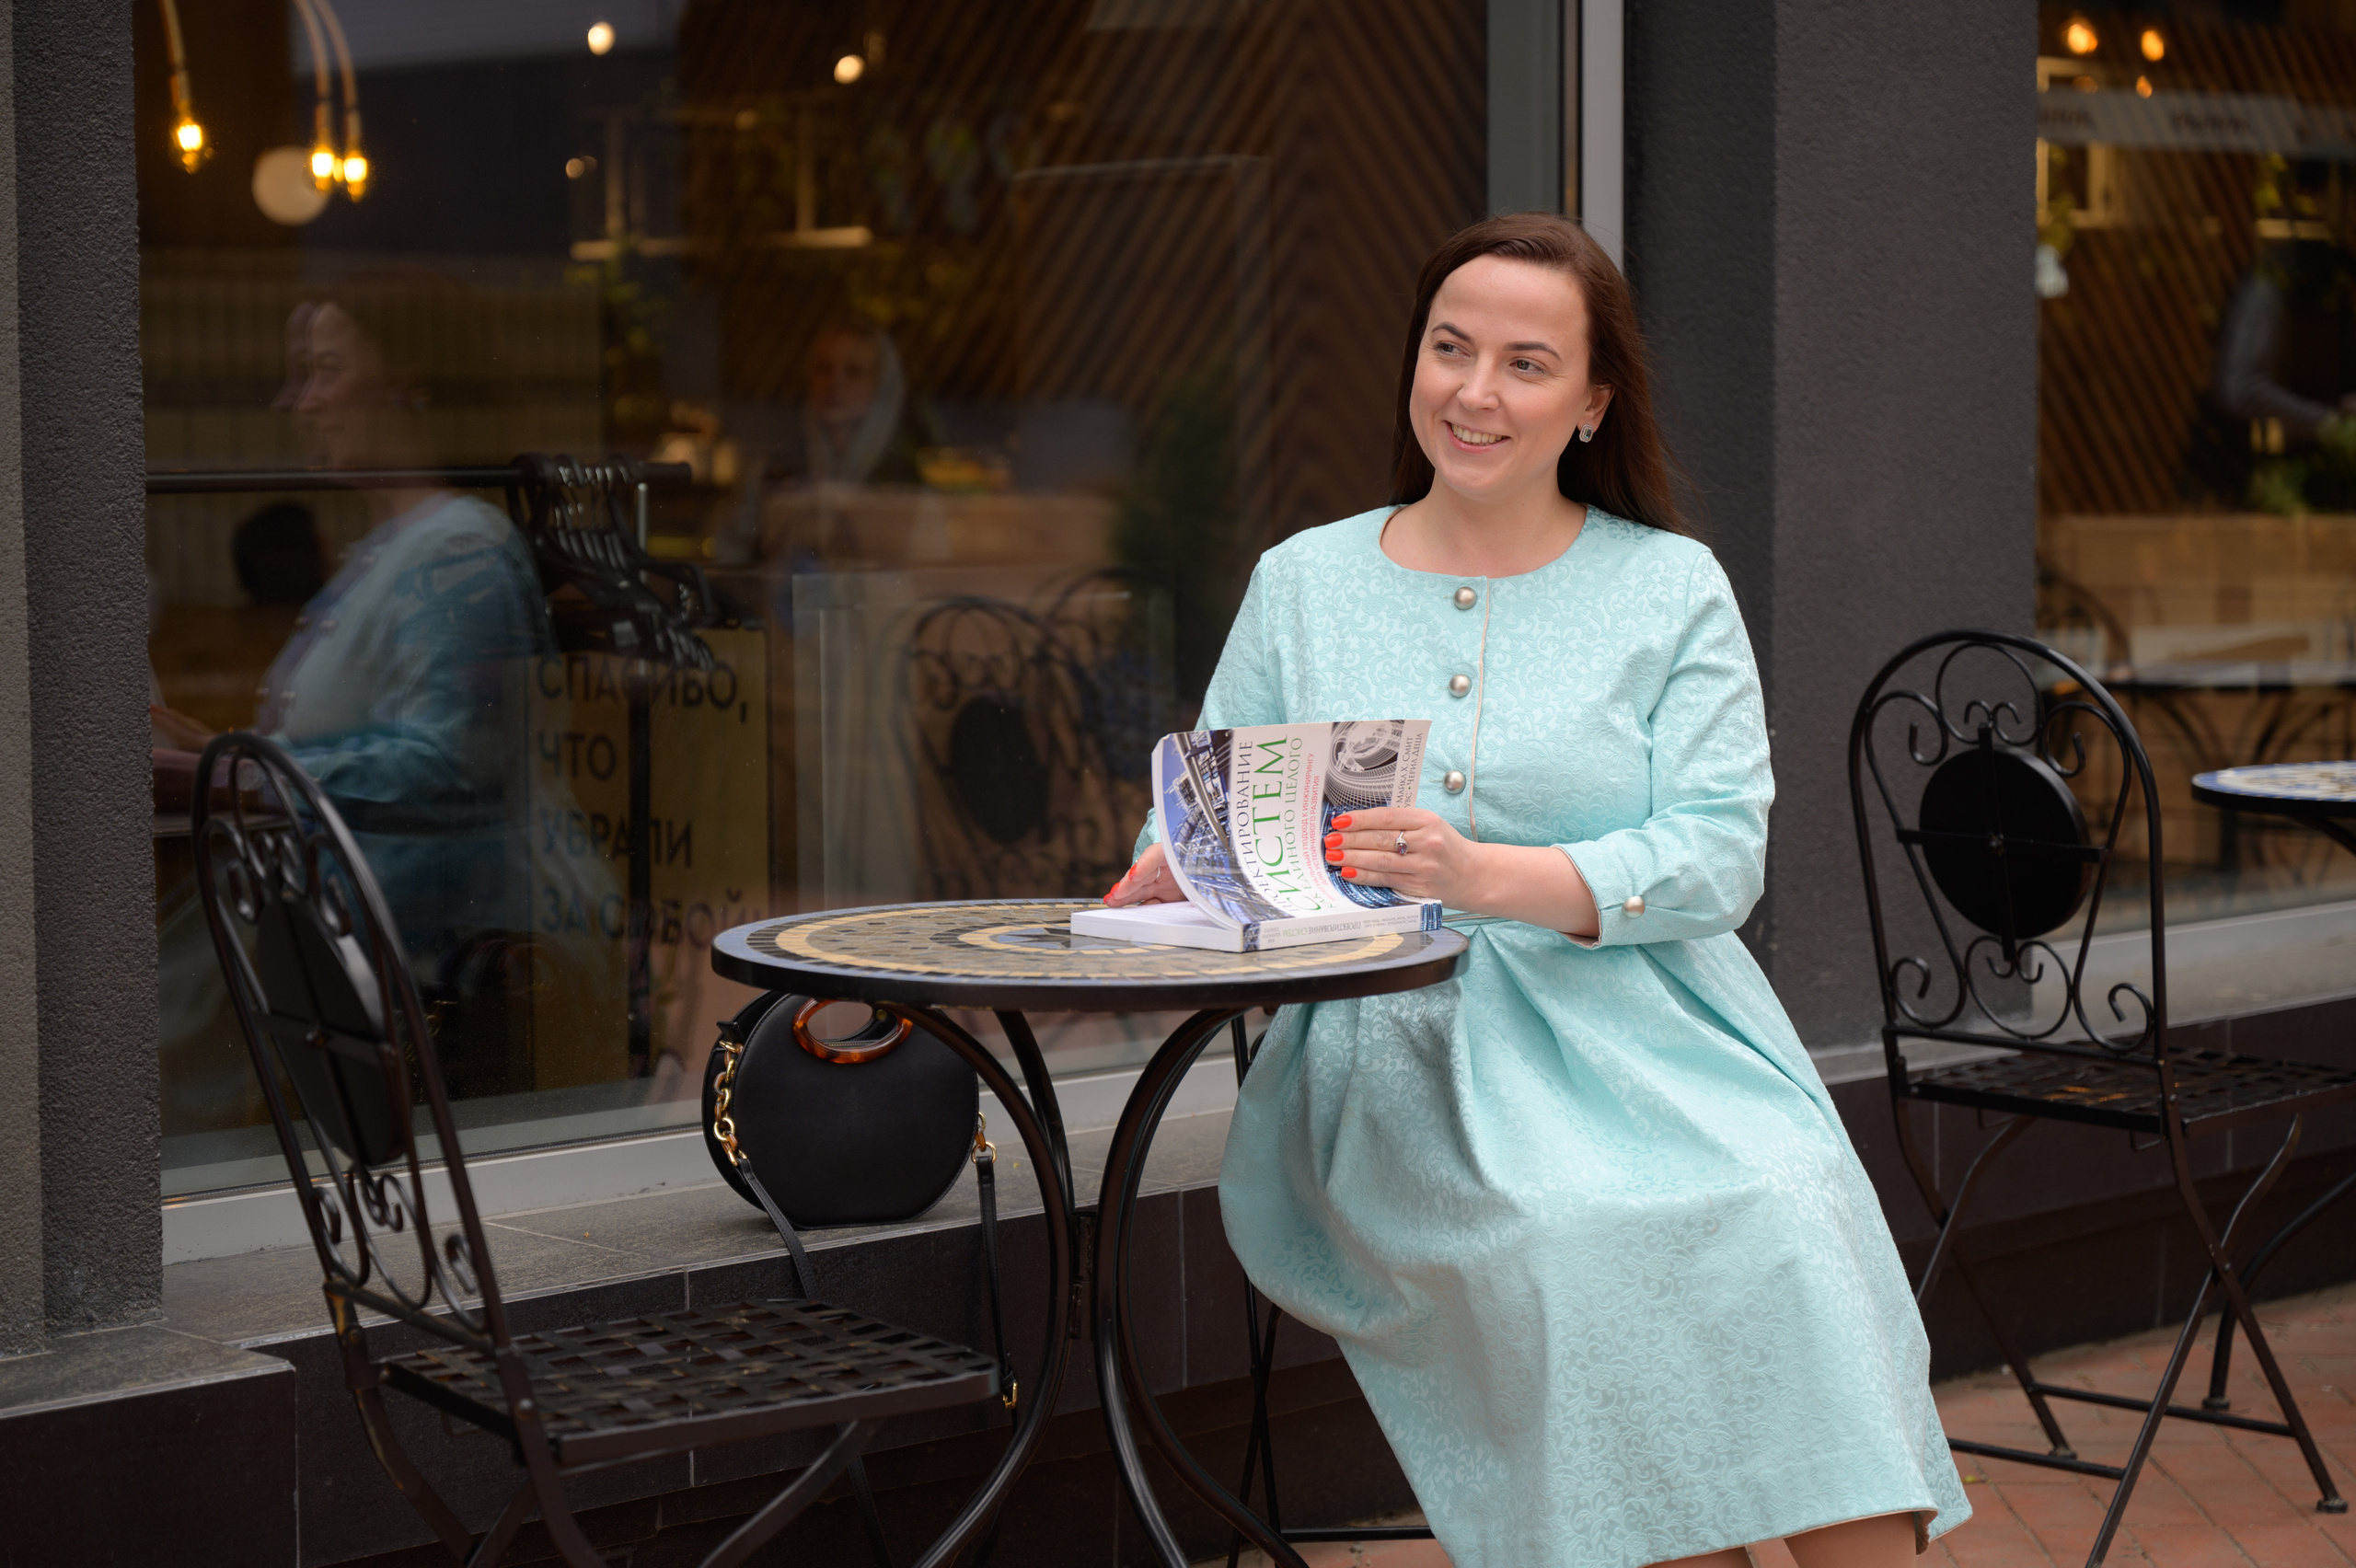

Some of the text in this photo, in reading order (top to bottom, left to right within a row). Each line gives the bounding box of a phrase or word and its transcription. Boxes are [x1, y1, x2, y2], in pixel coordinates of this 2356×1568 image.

[537, 732, 617, 782] ЧТО
[1284, 737, 1303, 803] ЦЕЛОГО
[1403, 737, 1414, 762] СМИТ
[1412, 732, 1423, 757] ДЕША
[1302, 753, 1315, 811] ИНЖИНИРИНГУ
[1311, 775, 1321, 814] РАЗВИТИЯ
[1407, 758, 1418, 786] ЧЕРИЛ
[1236, 741, 1299, 912] ПРОЕКТИРОВАНИЕ
[1253, 735, 1322, 911] СИСТЕМ
[1300, 819, 1310, 850] ПОДХОД
[1309, 816, 1322, 871] УСТОЙЧИВОГО
[1284, 809, 1312, 890] ЕДИНОГО
